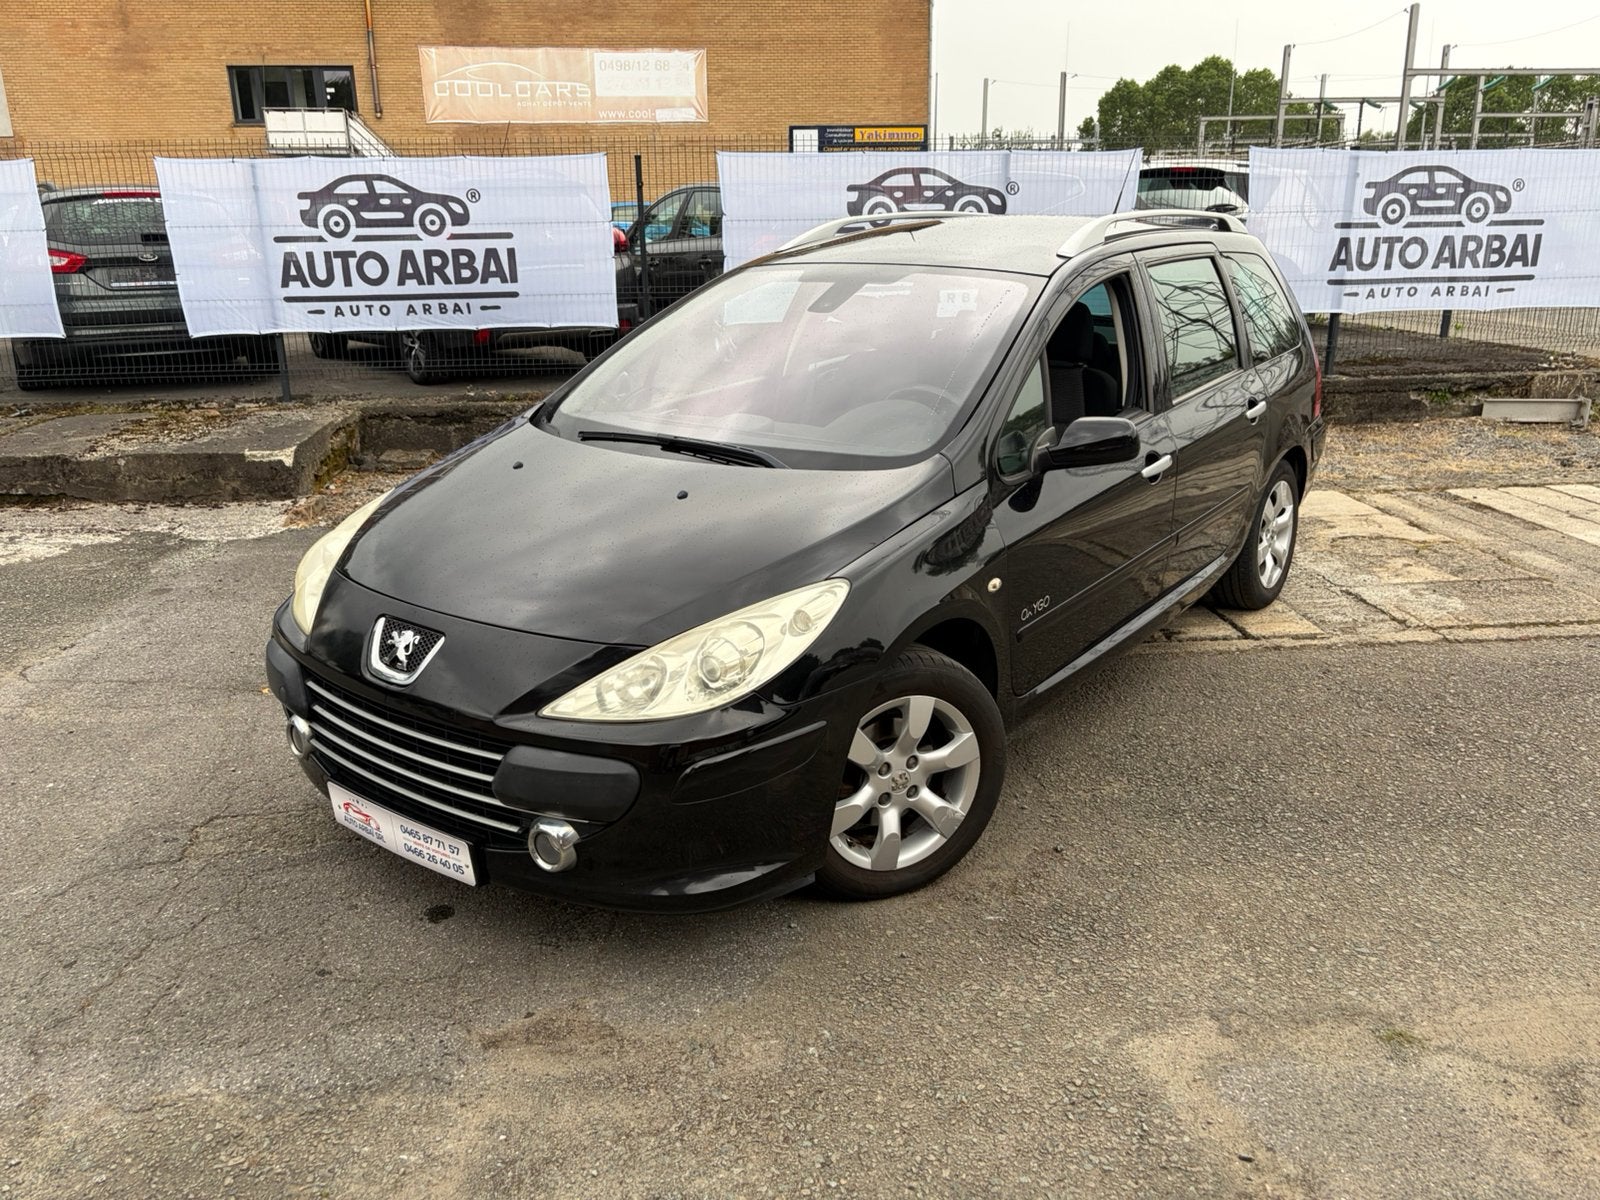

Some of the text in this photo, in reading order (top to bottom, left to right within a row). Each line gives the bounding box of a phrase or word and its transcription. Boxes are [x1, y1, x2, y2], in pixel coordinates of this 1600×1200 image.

[859, 129, 920, 141] Yakimmo
[280, 247, 519, 289] AUTO ARBAI
[1328, 233, 1543, 272] AUTO ARBAI
[1365, 285, 1491, 300] AUTO ARBAI
[334, 302, 472, 318] AUTO ARBAI
[400, 824, 460, 856] 0465 87 71 57
[404, 842, 465, 875] 0466 26 40 05
